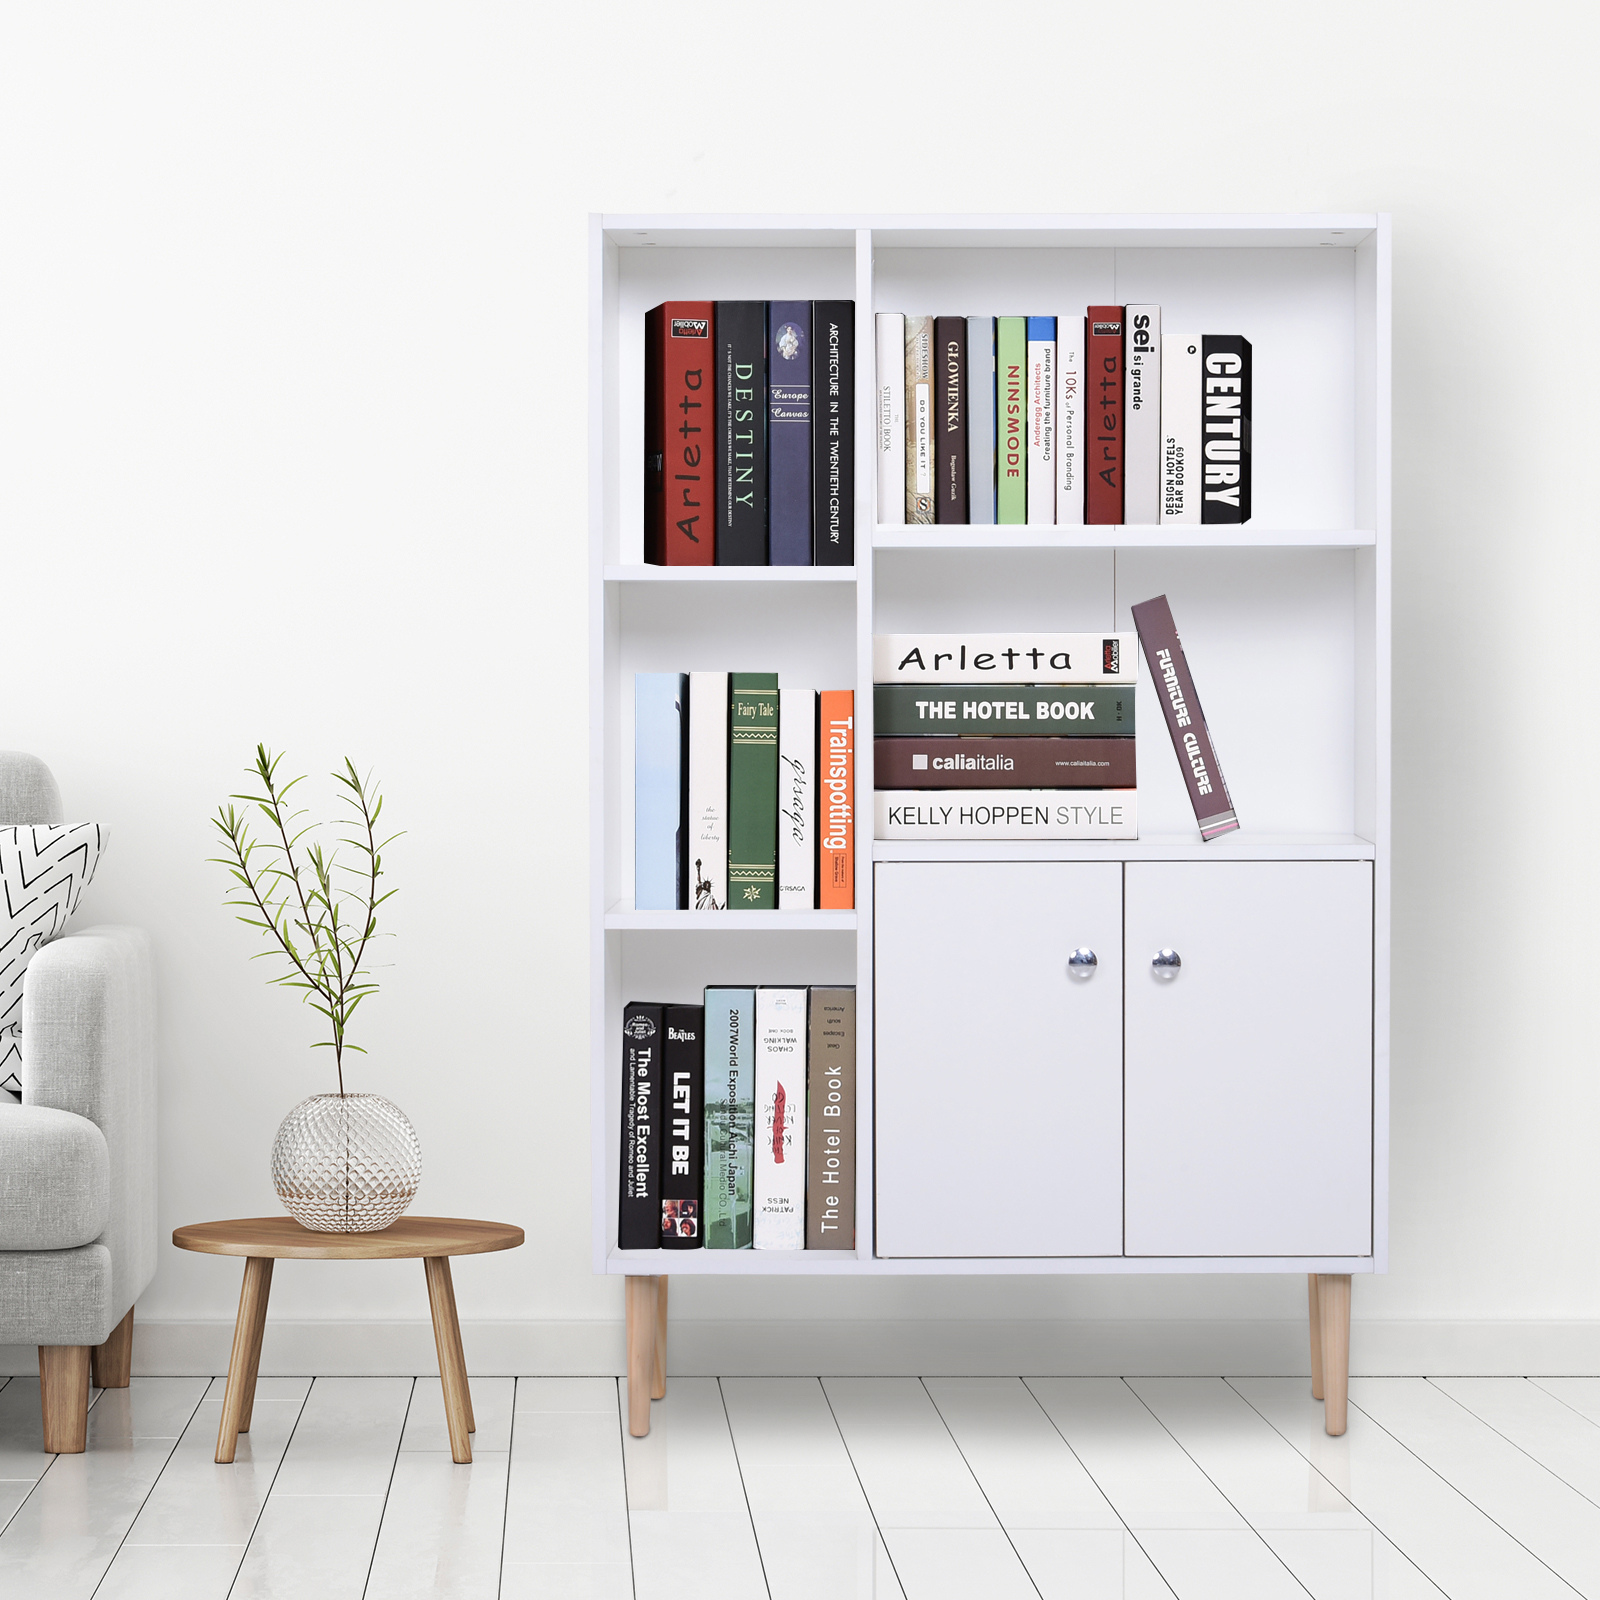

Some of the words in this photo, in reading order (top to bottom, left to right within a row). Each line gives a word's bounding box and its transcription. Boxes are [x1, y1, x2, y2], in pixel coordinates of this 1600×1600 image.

[1133, 315, 1155, 352] sei
[829, 323, 839, 396] ARCHITECTURE
[1134, 355, 1144, 365] si
[772, 389, 808, 402] Europe
[948, 341, 959, 432] GŁOWIENKA
[1043, 374, 1051, 409] furniture
[1065, 371, 1077, 400] 10Ks
[1131, 369, 1143, 410] grande
[771, 408, 809, 418] Canvas
[829, 402, 839, 413] IN
[883, 386, 891, 425] STILETTO
[920, 400, 926, 413] DO
[1007, 366, 1020, 478] NINSMODE
[1097, 356, 1116, 488] Arletta
[735, 362, 754, 508] DESTINY
[829, 417, 839, 436] THE
[883, 428, 891, 452] BOOK
[1034, 407, 1042, 447] Anderegg
[1043, 427, 1052, 461] Creating
[1066, 410, 1075, 449] Personal
[1205, 353, 1242, 507] CENTURY
[675, 368, 702, 543] Arletta
[829, 441, 839, 495] TWENTIETH
[920, 461, 926, 469] IT
[1064, 453, 1075, 491] Branding
[1166, 479, 1175, 515] DESIGN
[1175, 489, 1184, 515] YEAR
[829, 498, 839, 543] CENTURY
[899, 645, 1071, 670] Arletta
[738, 702, 757, 720] Fairy
[758, 702, 774, 716] Tale
[915, 701, 956, 719] THE
[963, 701, 1030, 720] HOTEL
[1036, 701, 1095, 720] BOOK
[932, 753, 1014, 770] caliaitalia
[1183, 732, 1213, 795] CULTURE
[889, 806, 953, 825] KELLY
[960, 806, 1048, 825] HOPPEN
[1056, 806, 1123, 825] STYLE
[668, 1027, 696, 1043] BEATLES
[729, 1009, 739, 1067] 2007World
[637, 1047, 652, 1077] The
[637, 1081, 651, 1121] Most
[673, 1072, 691, 1114] LET
[727, 1070, 738, 1128] Exposition
[823, 1066, 842, 1117] Book
[627, 1102, 636, 1130] Tragedy
[673, 1119, 690, 1141] IT
[629, 1131, 636, 1139] of
[728, 1132, 738, 1160] Aichi
[636, 1125, 651, 1198] Excellent
[672, 1145, 689, 1175] BE
[822, 1129, 841, 1184] Hotel
[726, 1162, 738, 1196] Japan
[821, 1196, 839, 1233] The
